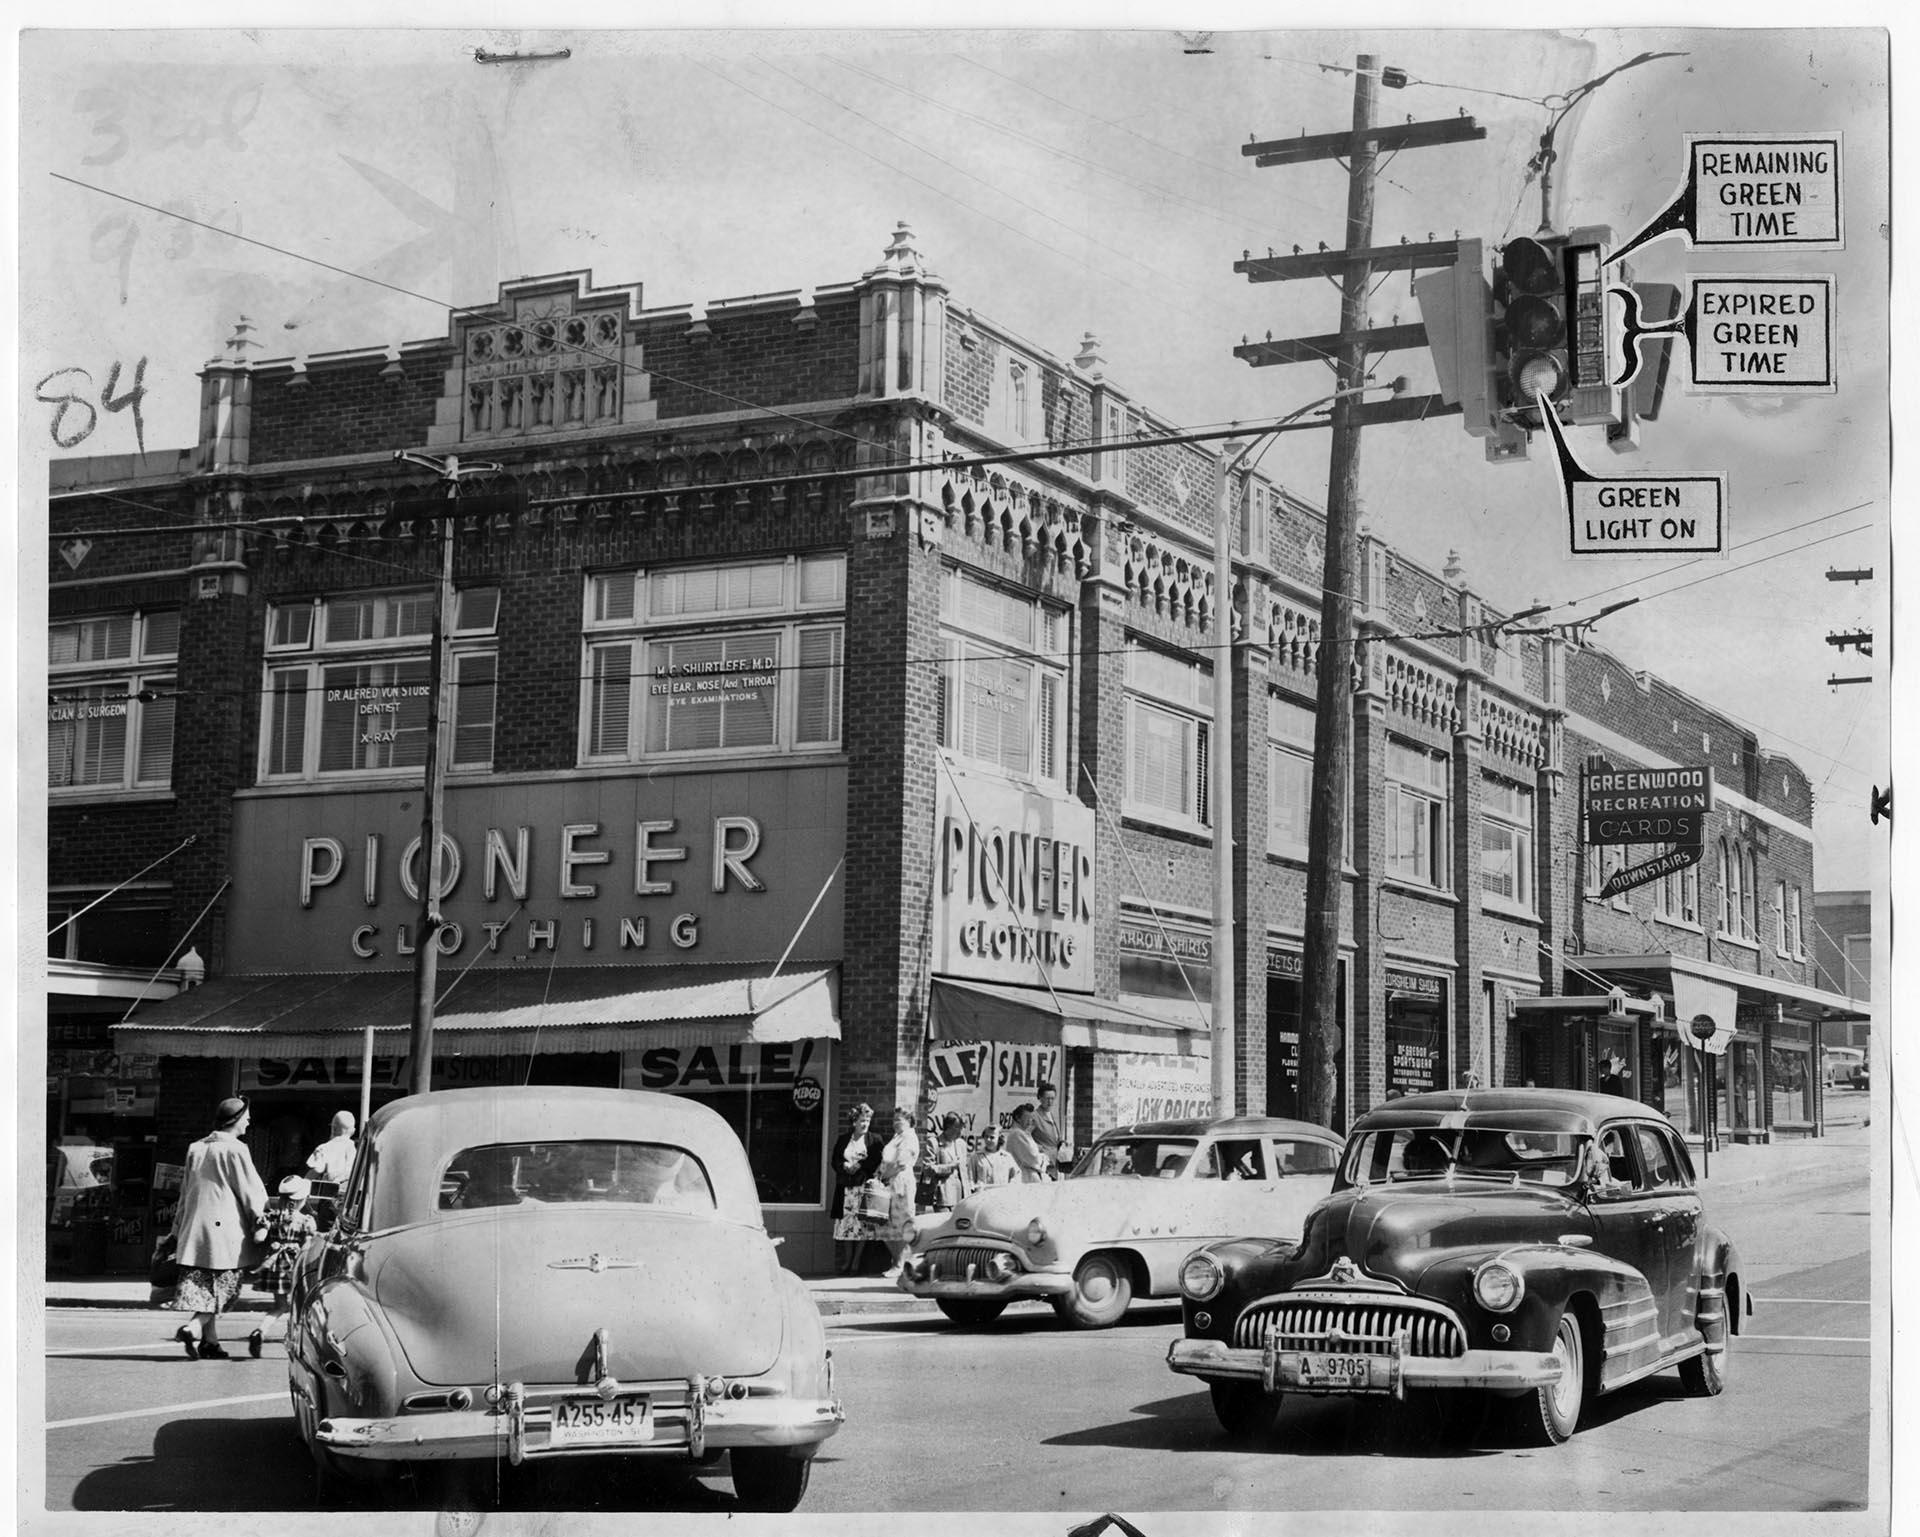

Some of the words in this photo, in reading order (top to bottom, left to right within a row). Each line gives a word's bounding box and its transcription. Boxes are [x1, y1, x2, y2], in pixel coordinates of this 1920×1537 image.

[36, 356, 149, 467] 84
[752, 657, 775, 670] M.D.
[697, 679, 720, 691] NOSE
[742, 675, 776, 688] THROAT
[327, 689, 341, 702] DR
[343, 687, 378, 701] ALFRED
[381, 686, 399, 698] VON
[670, 697, 686, 706] EYE
[691, 692, 758, 705] EXAMINATIONS
[77, 707, 85, 719] &
[88, 703, 127, 719] SURGEON
[360, 702, 401, 714] DENTIST
[360, 732, 398, 744] X-RAY
[1590, 771, 1704, 792] GREENWOOD
[1591, 793, 1705, 811] RECREATION
[1600, 817, 1690, 838] CARDS
[301, 815, 766, 908] PIONEER
[941, 815, 1091, 924] PIONEER
[1611, 851, 1691, 889] DOWNSTAIRS
[352, 912, 698, 957] CLOTHING
[959, 919, 1076, 969] CLOTHING
[1119, 929, 1163, 949] ARROW
[1169, 936, 1209, 957] SHIRTS
[258, 1057, 407, 1086] SALE!
[641, 1040, 814, 1088] SALE!
[998, 1050, 1056, 1087] SALE!
[1301, 1357, 1312, 1375] A
[1328, 1358, 1366, 1377] 9705
